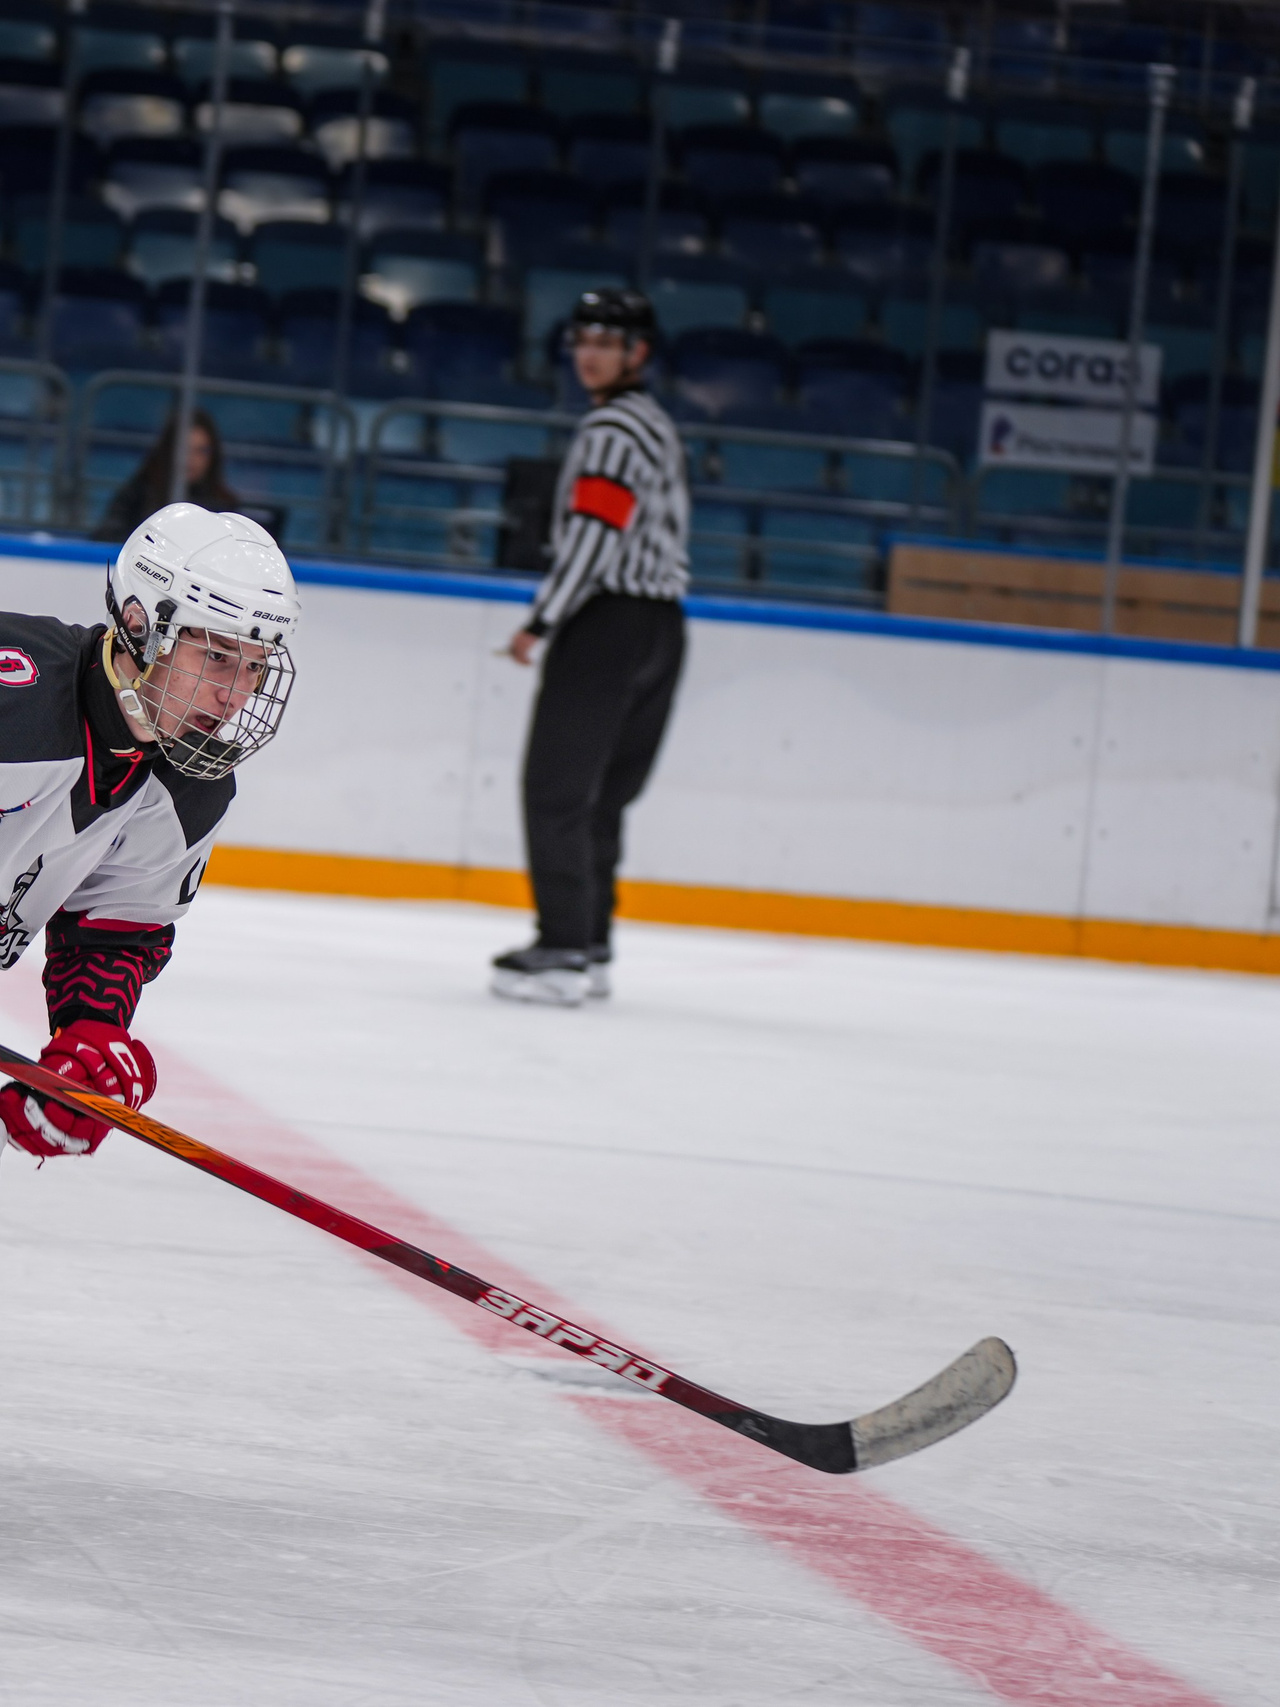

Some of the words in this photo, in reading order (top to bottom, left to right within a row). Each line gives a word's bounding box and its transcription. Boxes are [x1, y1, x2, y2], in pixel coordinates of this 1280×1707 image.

[135, 561, 169, 584] BAUER
[252, 610, 291, 625] BAUER
[119, 627, 138, 656] BAUER
